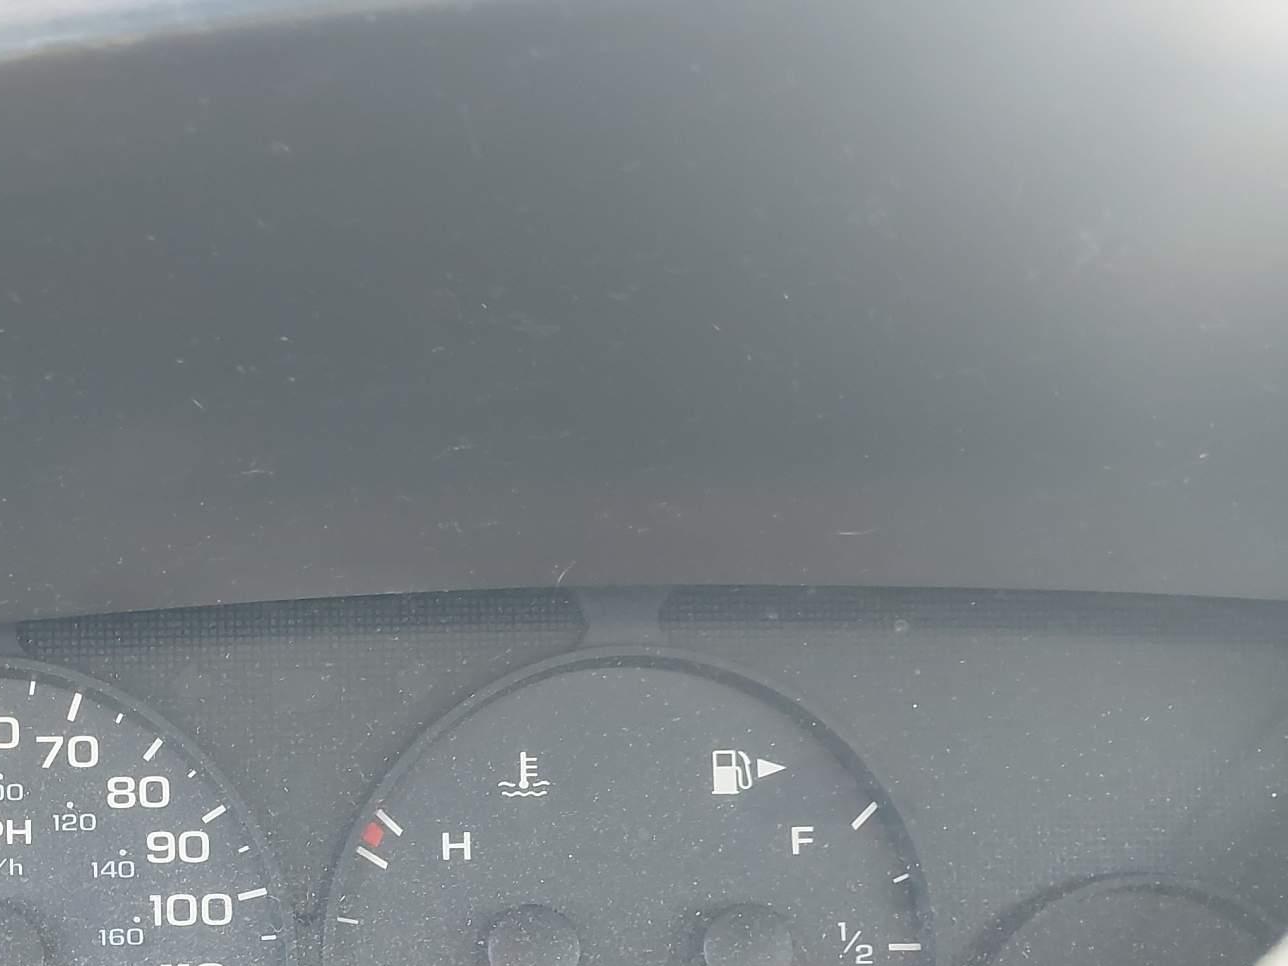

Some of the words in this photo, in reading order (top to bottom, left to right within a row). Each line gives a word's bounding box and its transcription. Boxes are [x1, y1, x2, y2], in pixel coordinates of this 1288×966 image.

[36, 735, 99, 768] 70
[106, 775, 170, 809] 80
[52, 813, 97, 832] 120
[146, 830, 210, 864] 90
[441, 831, 472, 860] H
[791, 826, 814, 854] F
[90, 860, 136, 879] 140
[150, 893, 232, 927] 100
[98, 928, 144, 946] 160
